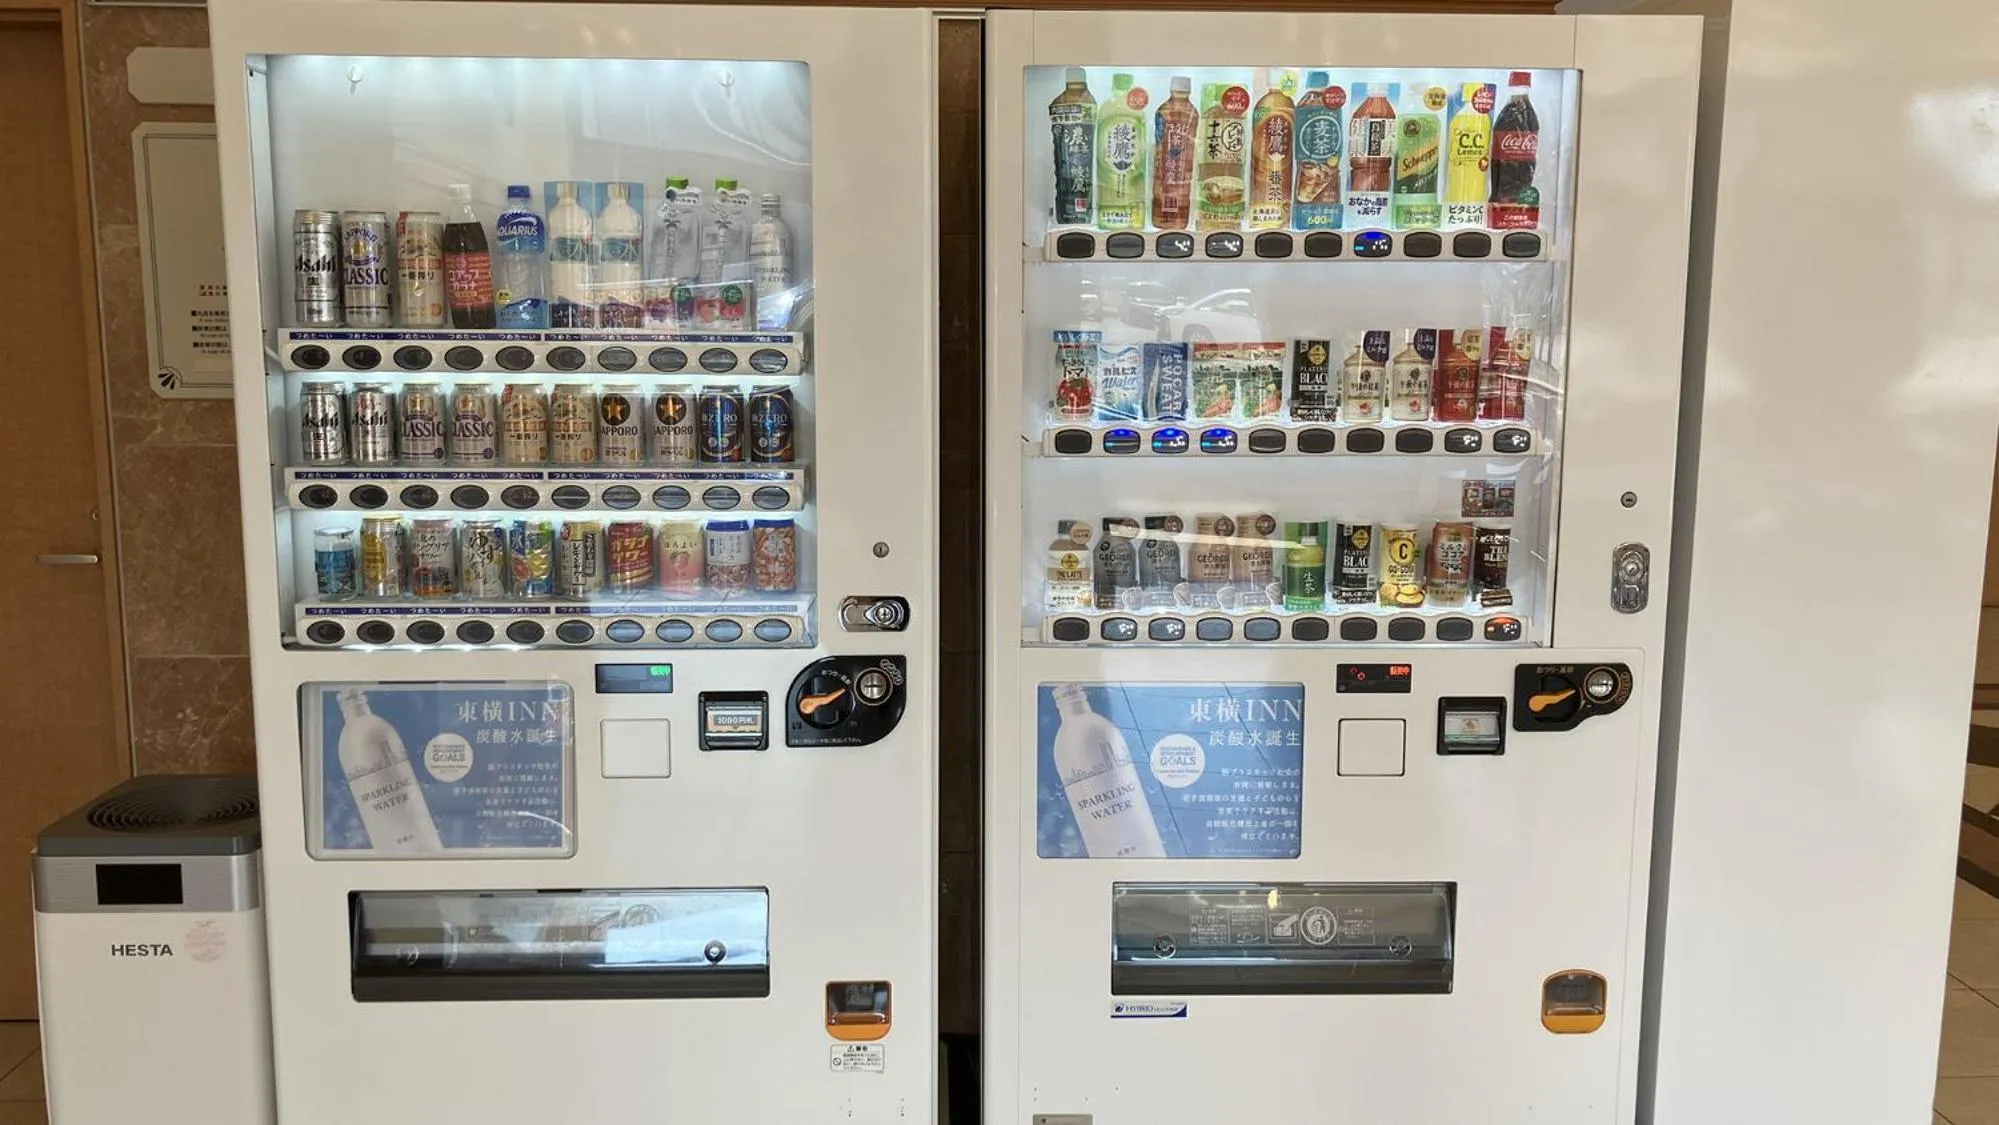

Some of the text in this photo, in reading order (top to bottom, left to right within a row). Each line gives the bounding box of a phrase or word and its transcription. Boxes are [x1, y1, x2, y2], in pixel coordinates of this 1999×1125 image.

[1206, 119, 1221, 161] 十六茶
[1314, 119, 1331, 153] 麦茶
[497, 226, 539, 236] QUARIUS
[295, 254, 336, 273] Asahi
[345, 267, 389, 286] LASSIC
[1161, 355, 1173, 412] SWEAT
[1299, 373, 1328, 384] BLAC
[401, 420, 444, 437] LASSIC
[452, 420, 494, 437] LASSIC
[601, 426, 638, 436] APPORO
[664, 540, 697, 549] ほろよい
[1343, 556, 1369, 567] BLAC
[457, 700, 560, 724] 東横INN
[1189, 699, 1301, 723] 東横INN
[475, 728, 559, 745] 炭酸水誕生
[1208, 729, 1300, 747] 炭酸水誕生
[372, 793, 410, 812] WATER
[1076, 783, 1137, 810] SPARKLING
[1090, 799, 1135, 821] WATER
[111, 944, 173, 957] HESTA
